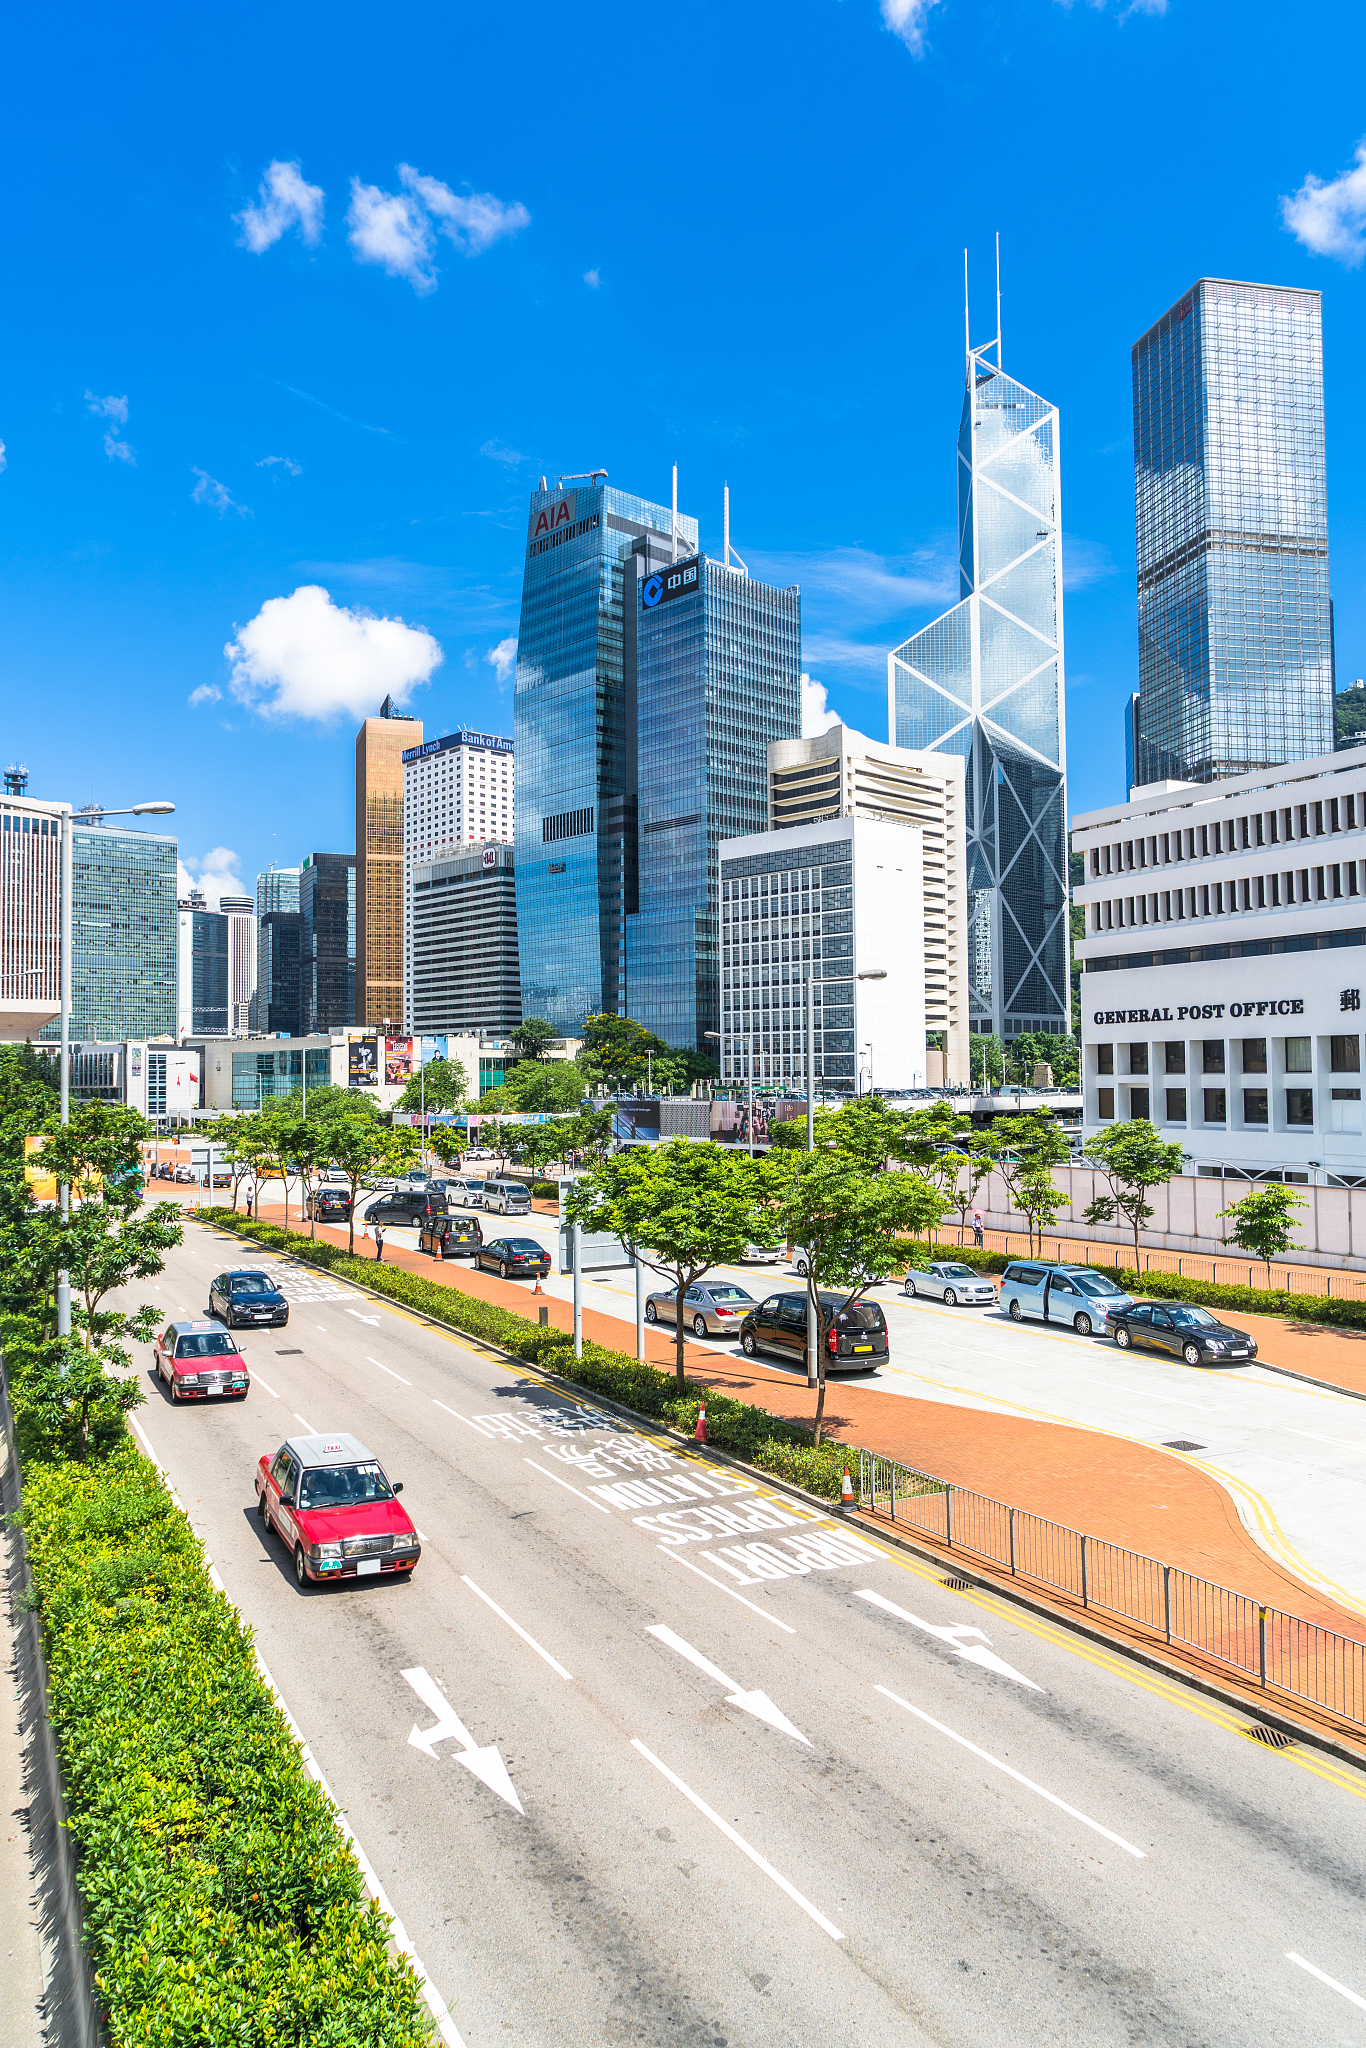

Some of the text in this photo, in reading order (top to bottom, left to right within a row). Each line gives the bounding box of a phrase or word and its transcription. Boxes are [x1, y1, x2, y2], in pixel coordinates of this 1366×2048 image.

[534, 501, 571, 537] AIA
[667, 565, 698, 590] 中国
[402, 740, 441, 762] Merrill Lynch
[461, 731, 485, 747] Bank
[485, 735, 497, 748] of
[1093, 999, 1304, 1025] GENERAL POST OFFICE
[1339, 988, 1361, 1012] 郵
[543, 1435, 690, 1479] 機場
[587, 1469, 760, 1511] STATION
[631, 1494, 831, 1546] EXPRESS
[698, 1527, 893, 1586] AIRPORT
